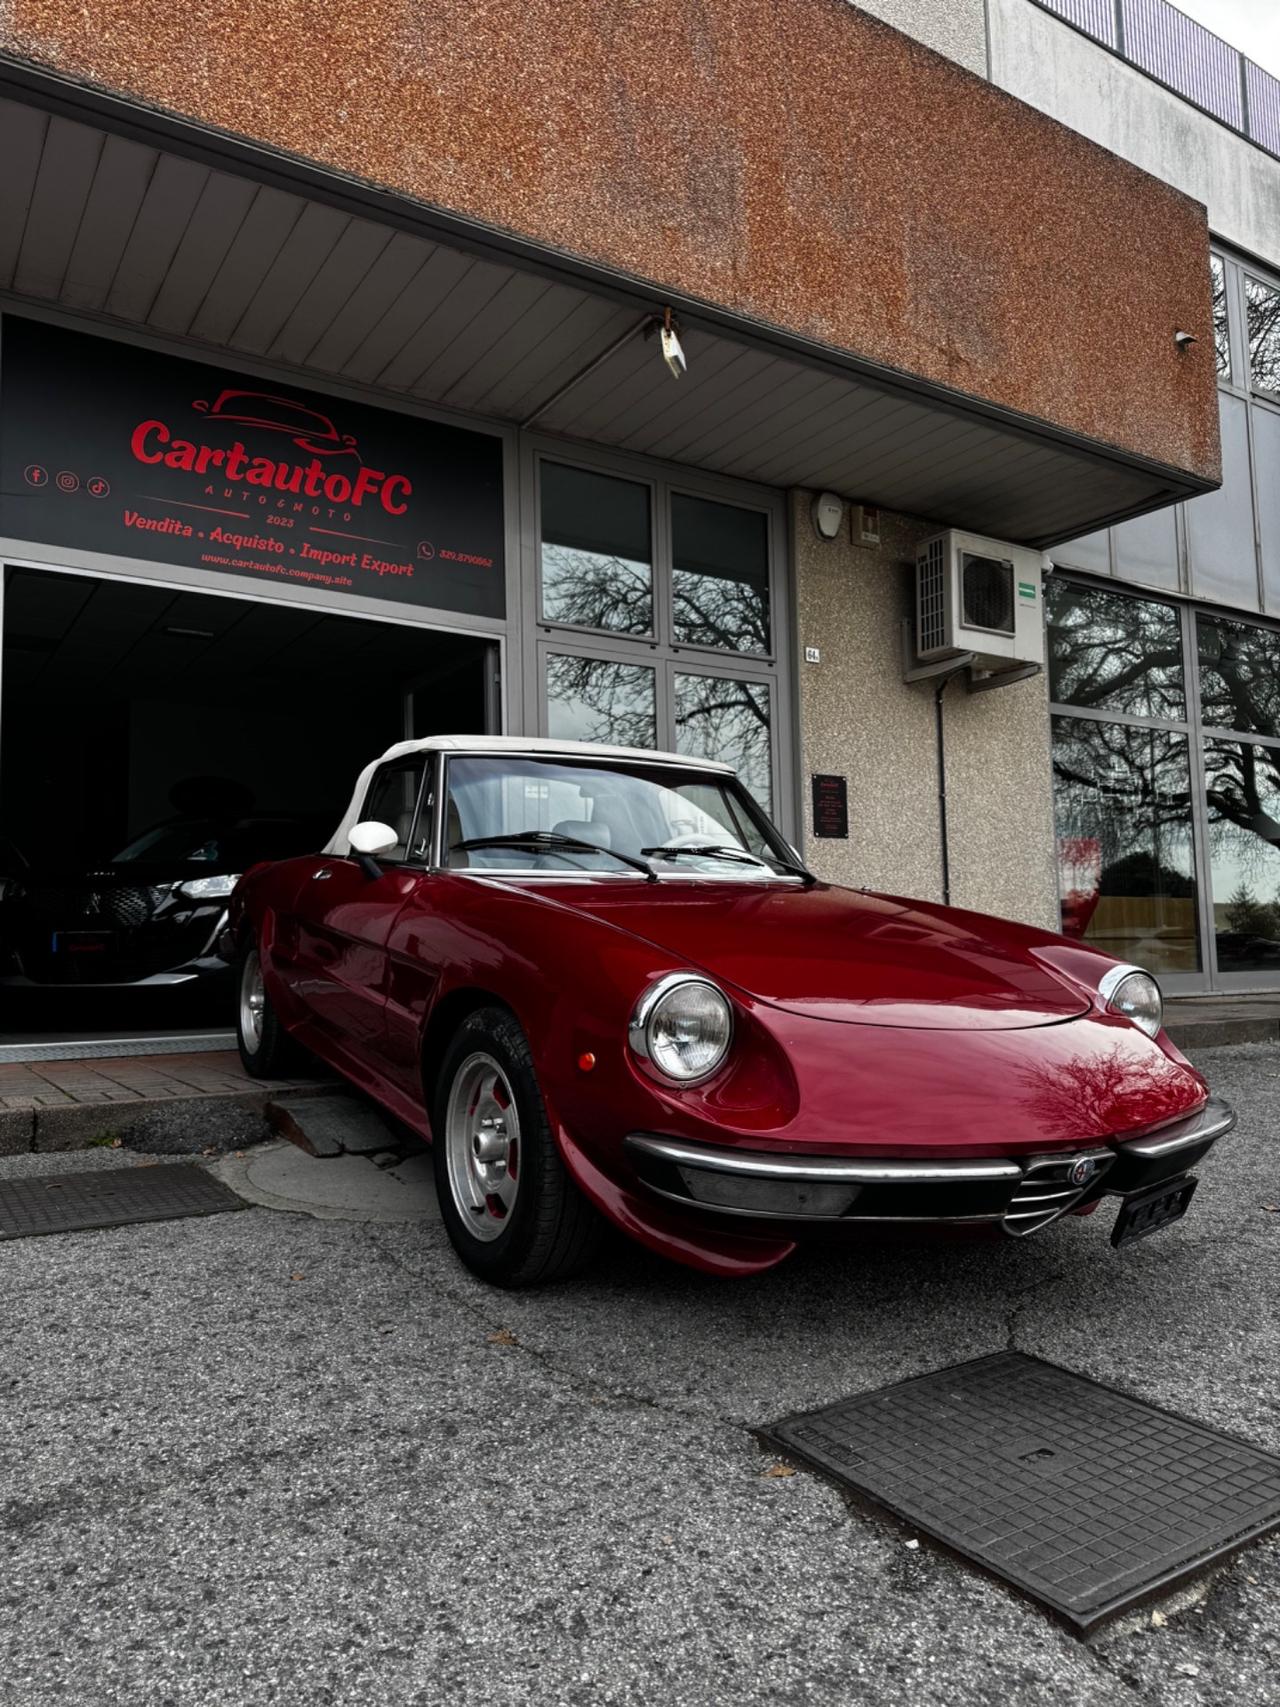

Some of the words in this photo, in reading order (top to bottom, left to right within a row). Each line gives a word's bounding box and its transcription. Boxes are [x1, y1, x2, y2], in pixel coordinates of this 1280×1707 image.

[131, 419, 412, 515] CartautoFC
[123, 510, 193, 537] Vendita
[209, 527, 285, 552] Acquisto
[300, 542, 357, 566] Import
[360, 554, 415, 576] Export
[201, 554, 353, 586] www.cartautofc.company.site
